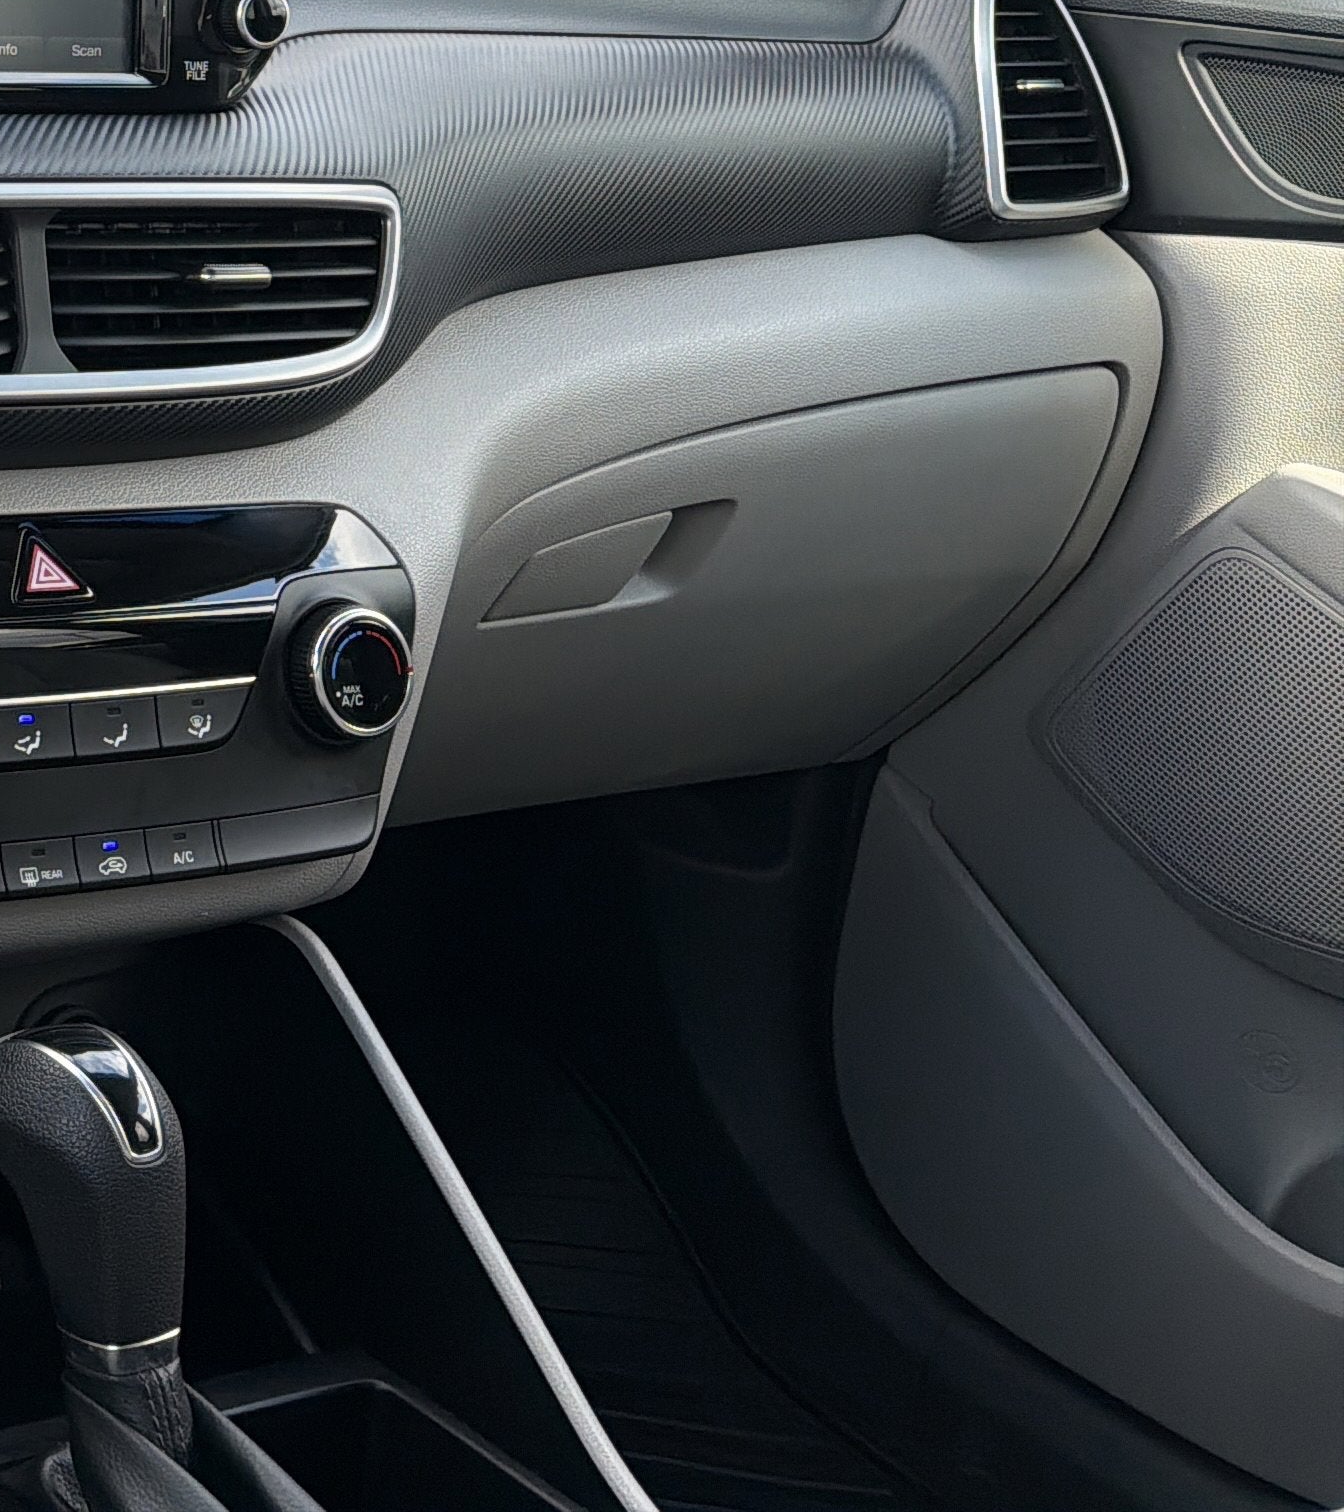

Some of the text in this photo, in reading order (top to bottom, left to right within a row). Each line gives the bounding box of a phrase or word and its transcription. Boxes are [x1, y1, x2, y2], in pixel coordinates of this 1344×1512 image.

[71, 45, 102, 57] Scan
[184, 61, 209, 71] TUNE
[186, 70, 207, 81] FILE
[341, 694, 364, 708] A/C
[173, 851, 195, 865] A/C
[41, 870, 63, 880] REAR
